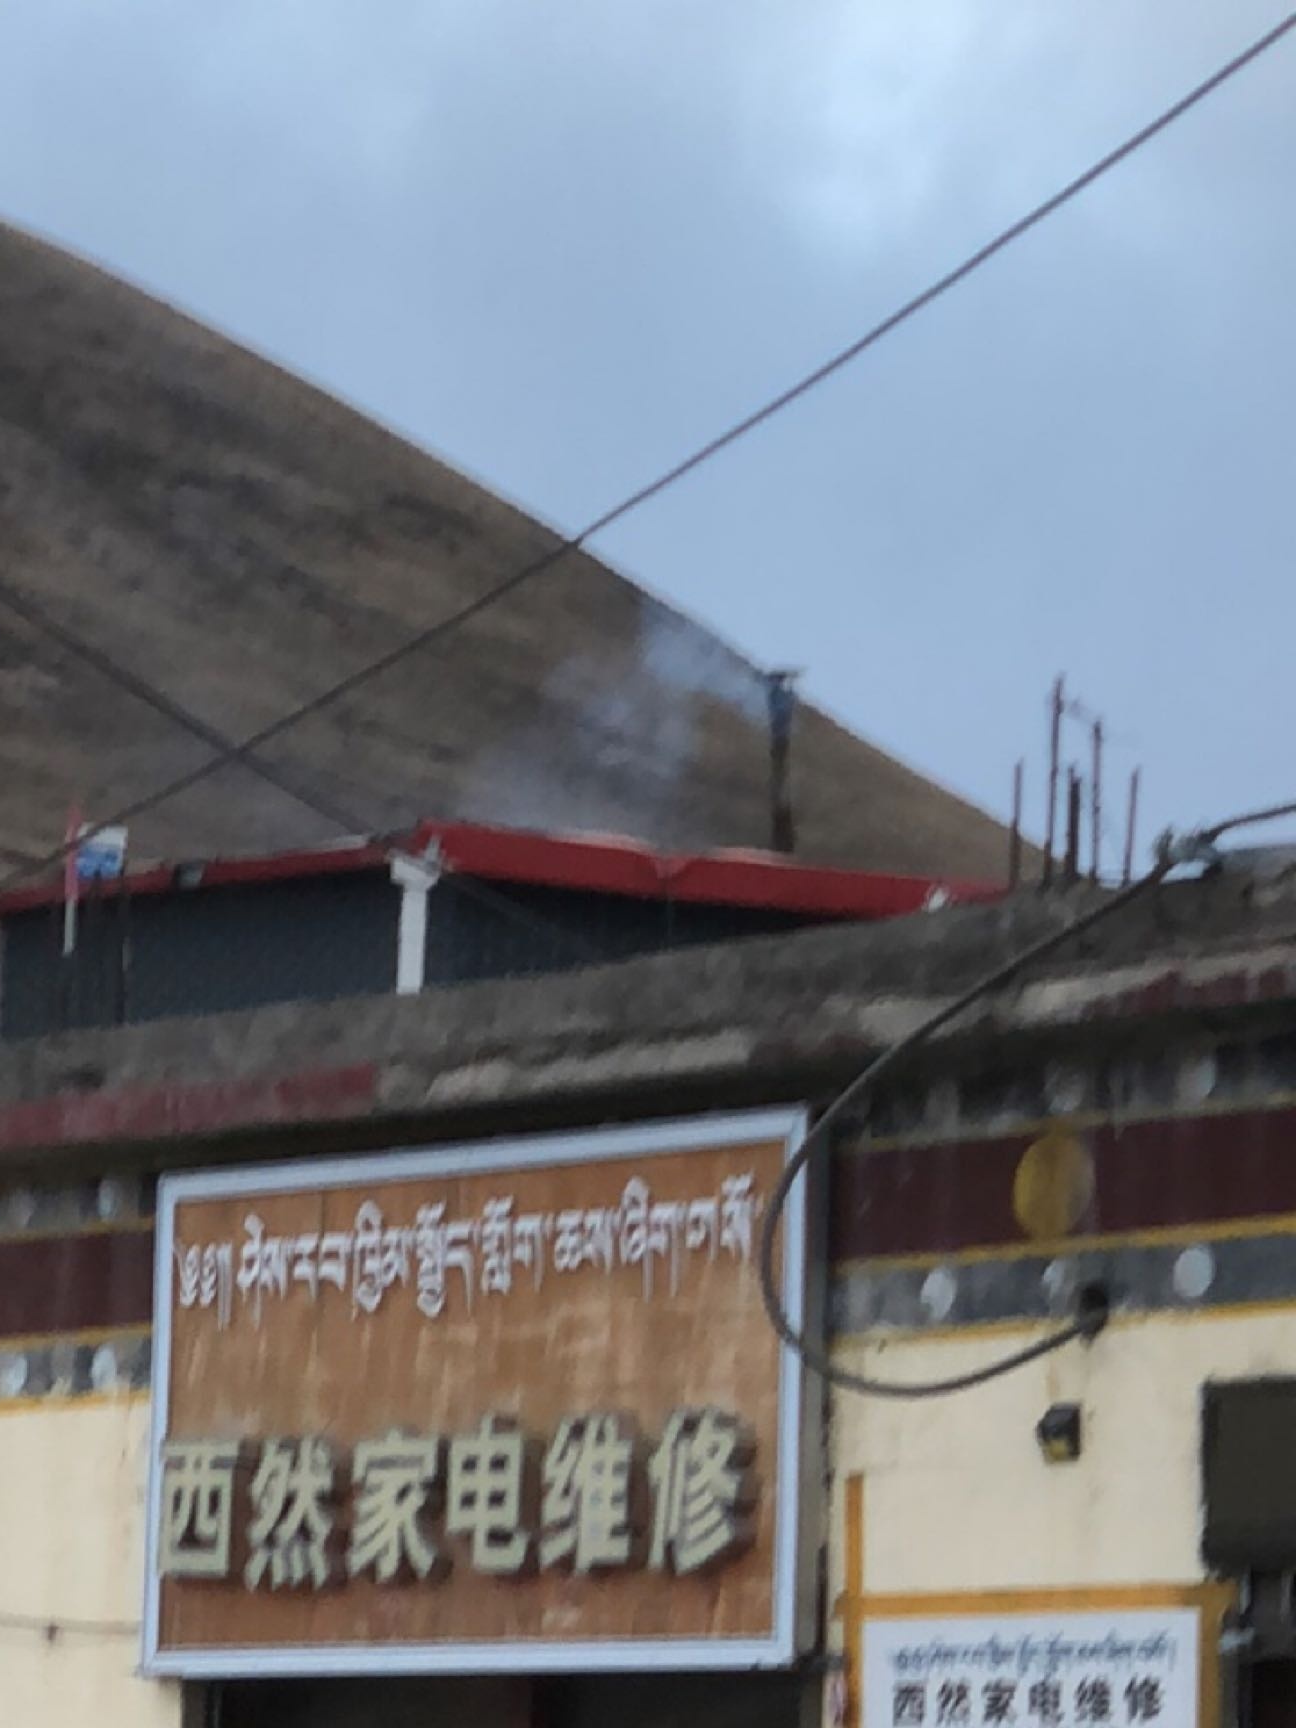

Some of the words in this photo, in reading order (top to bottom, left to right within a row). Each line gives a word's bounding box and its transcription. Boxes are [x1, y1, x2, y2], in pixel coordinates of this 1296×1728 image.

[159, 1407, 749, 1592] 西然家电维修
